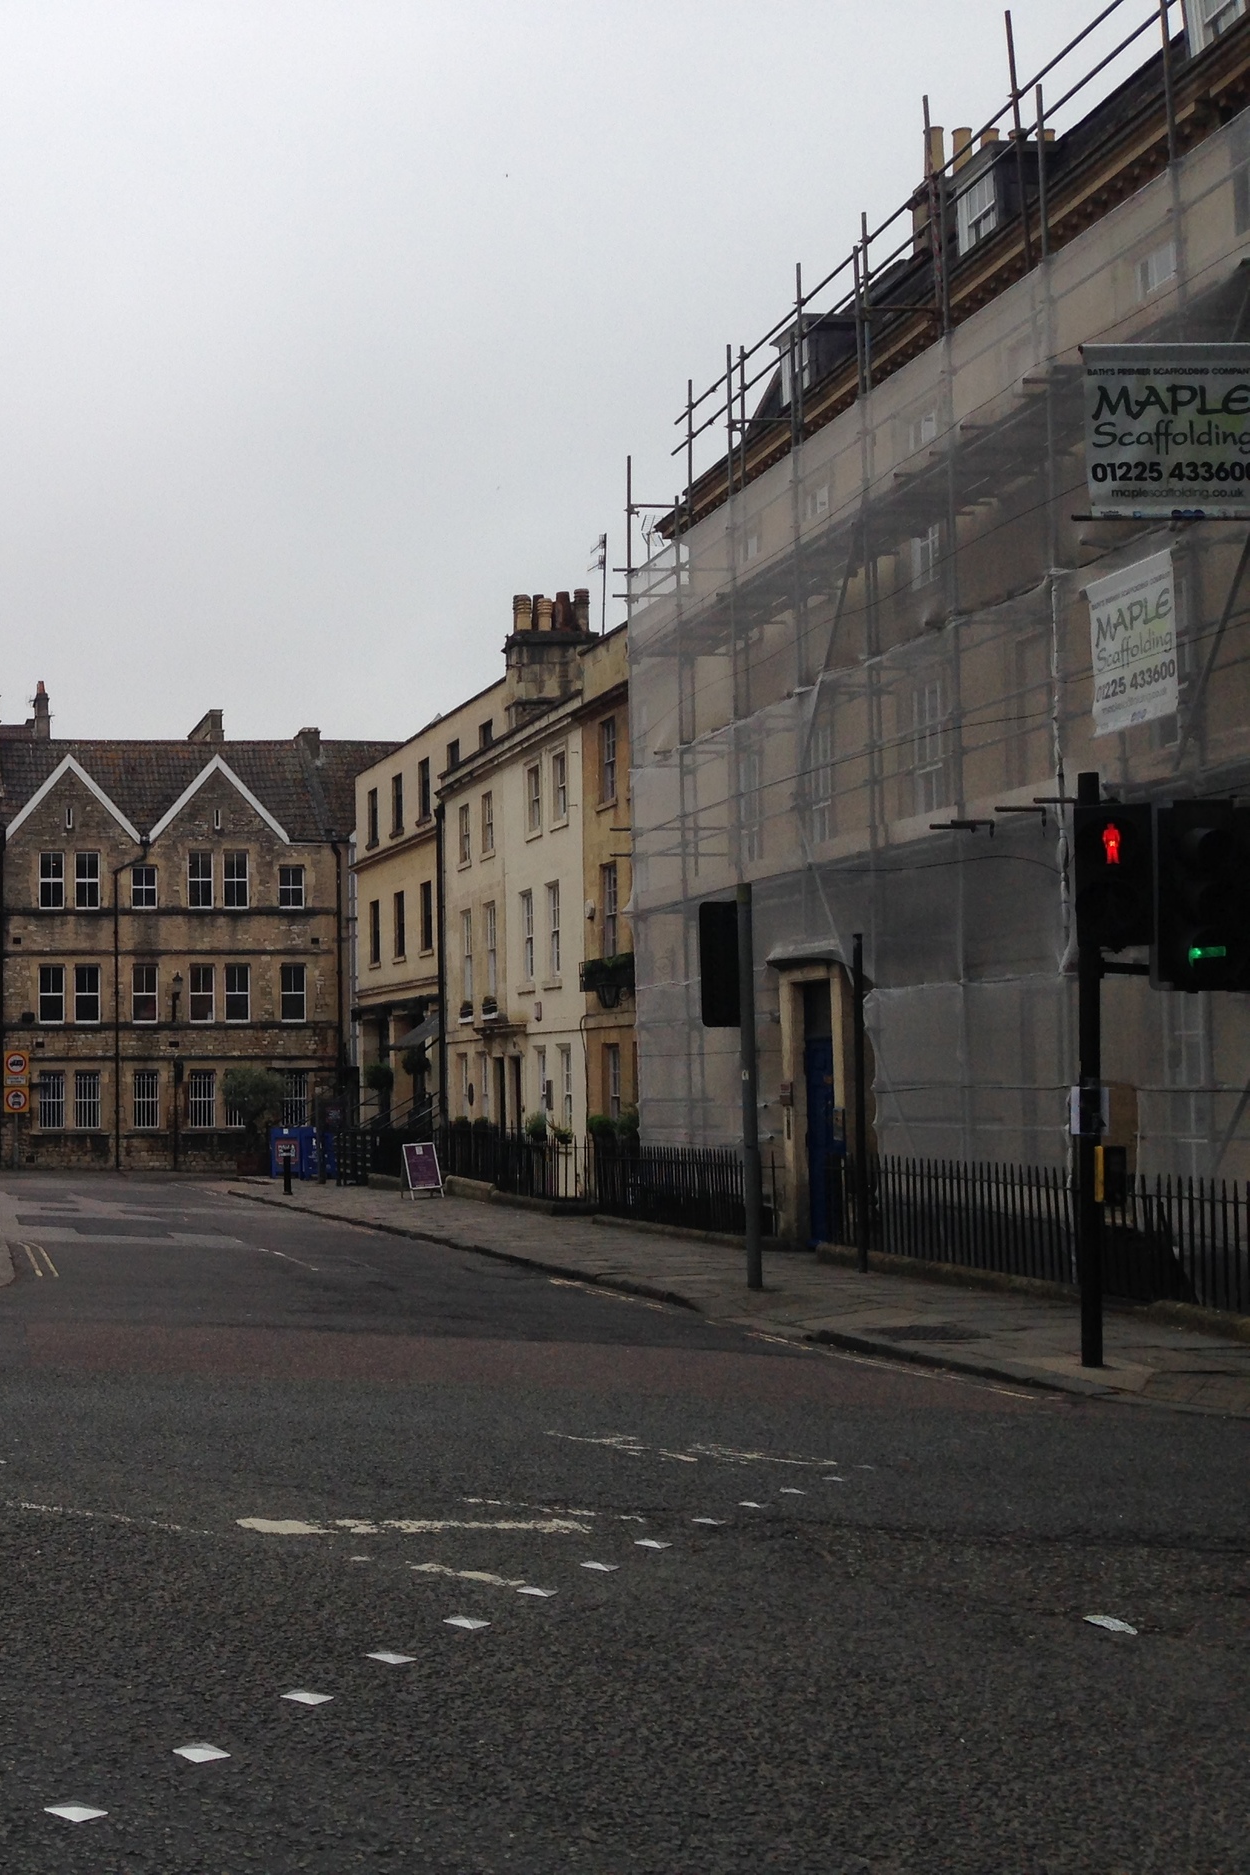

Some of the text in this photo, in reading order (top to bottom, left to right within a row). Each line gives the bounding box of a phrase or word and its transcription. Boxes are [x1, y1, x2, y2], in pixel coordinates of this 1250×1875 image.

[1087, 367, 1250, 376] BATH'S PREMIER SCAFFOLDING COMPAN
[1092, 384, 1250, 421] MAPLE
[1092, 419, 1250, 455] Scaffolding
[1092, 462, 1163, 482] 01225
[1111, 487, 1244, 500] maplescaffolding.co.uk
[1095, 587, 1172, 648] MAPLE
[1096, 630, 1173, 672] Scaffolding
[1096, 659, 1176, 703] 01225 433600
